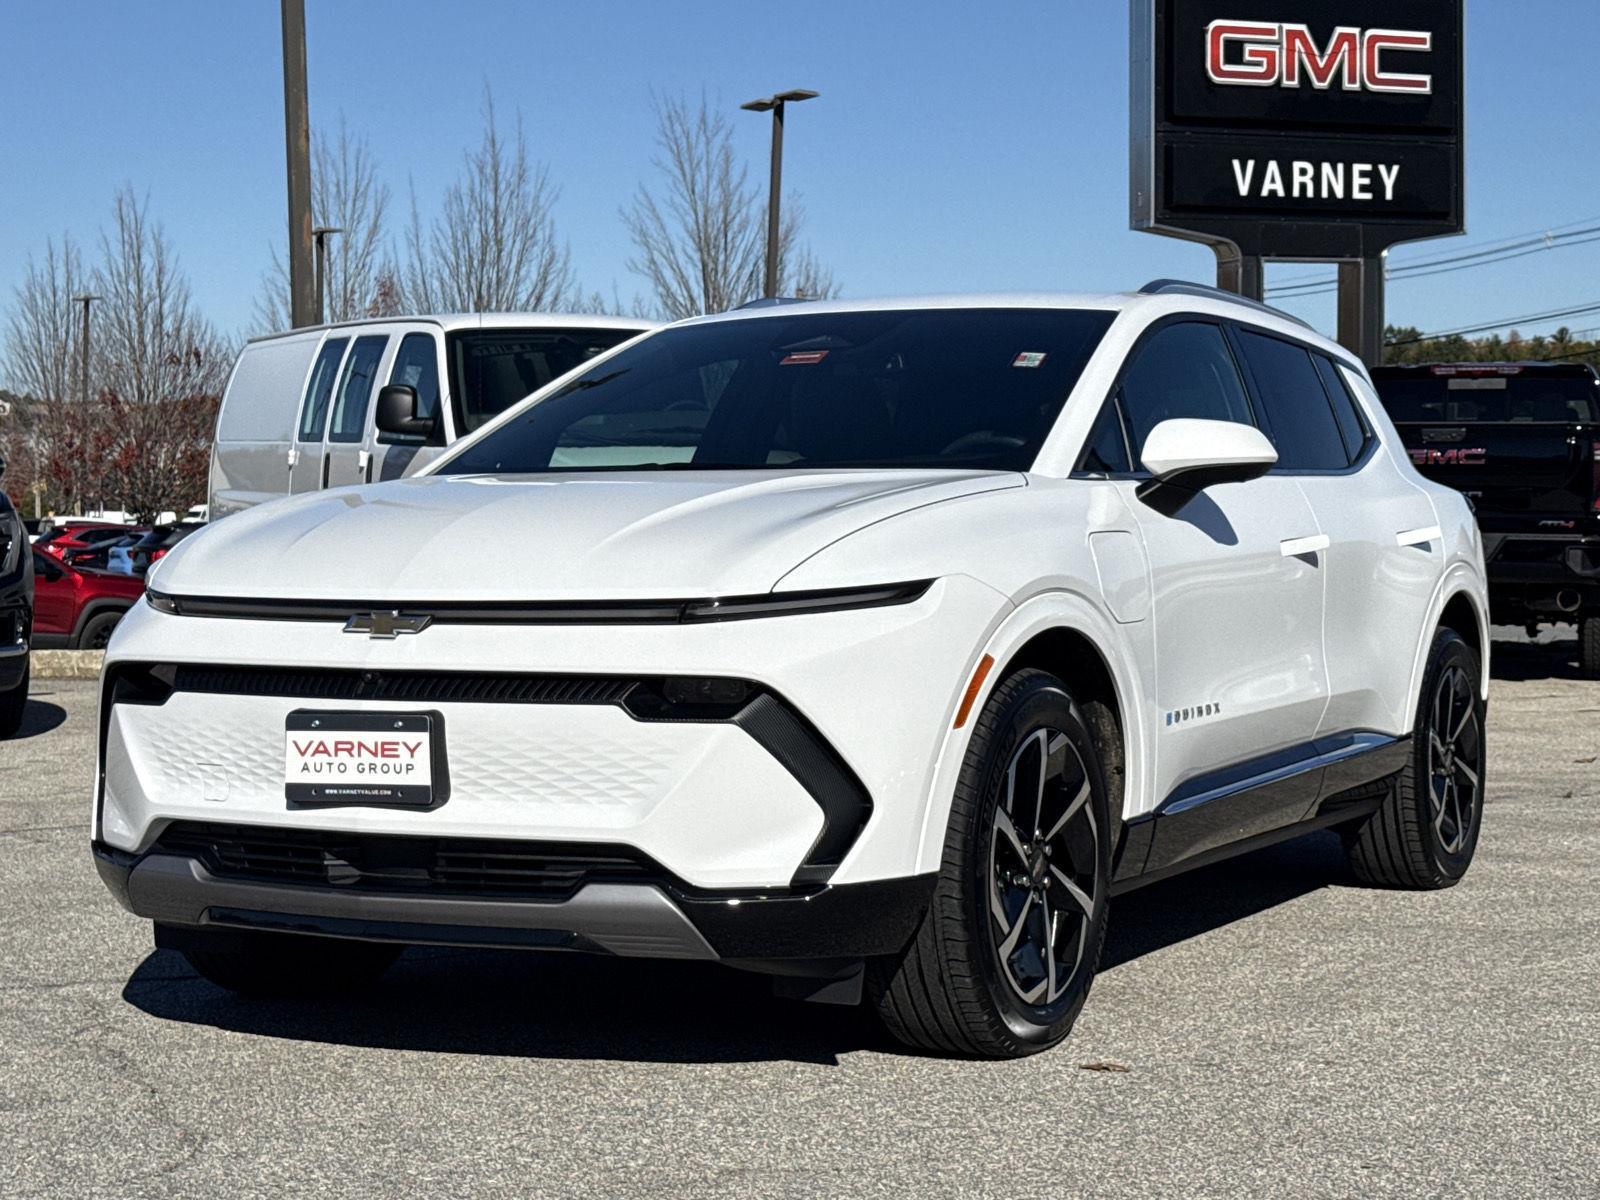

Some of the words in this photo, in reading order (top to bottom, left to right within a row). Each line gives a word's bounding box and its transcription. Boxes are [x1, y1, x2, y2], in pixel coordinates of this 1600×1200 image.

[1205, 18, 1432, 94] GMC
[1231, 158, 1400, 201] VARNEY
[292, 740, 423, 759] VARNEY
[300, 762, 348, 774] AUTO
[356, 762, 415, 775] GROUP
